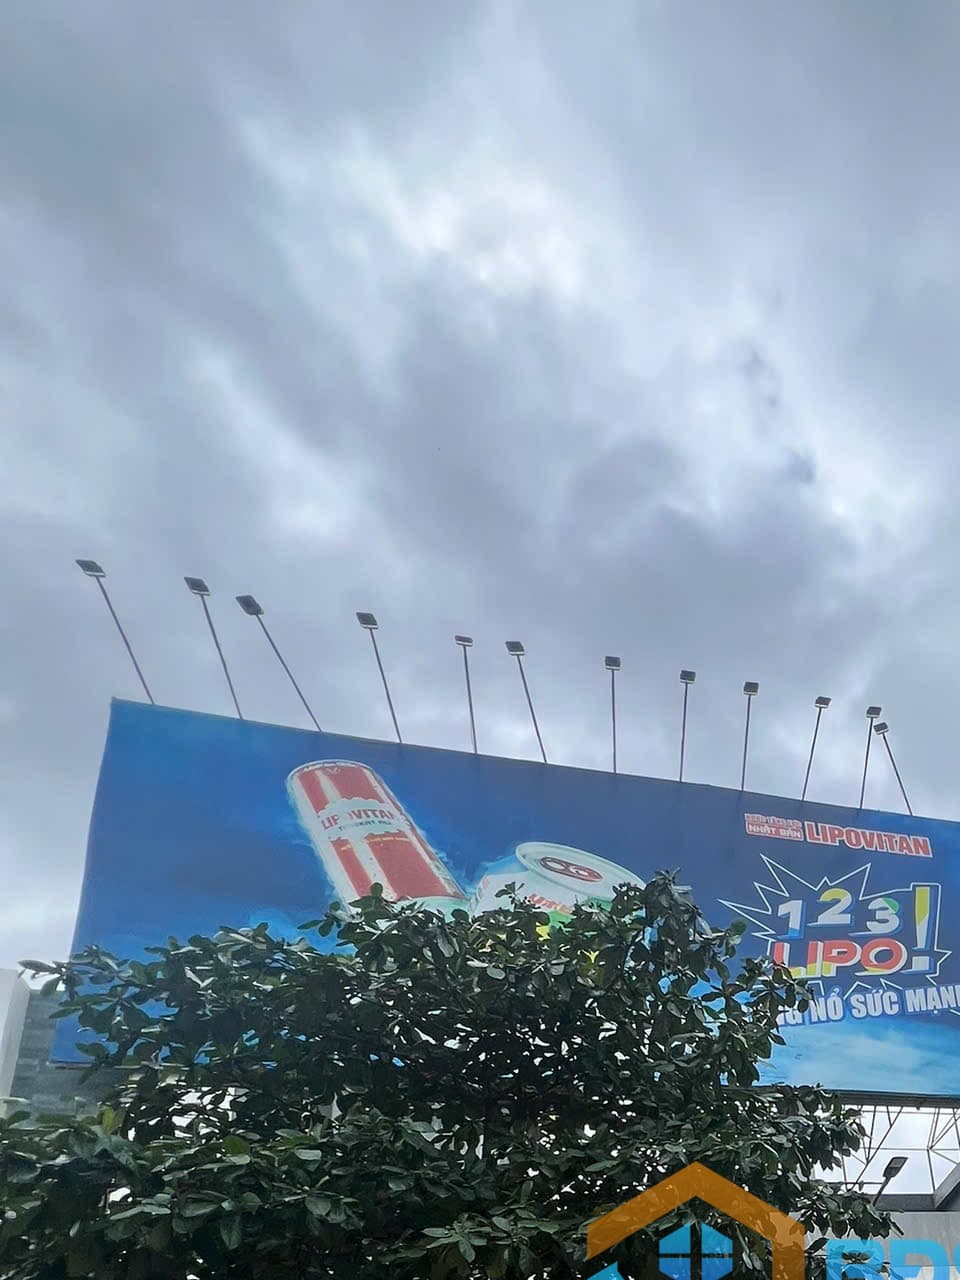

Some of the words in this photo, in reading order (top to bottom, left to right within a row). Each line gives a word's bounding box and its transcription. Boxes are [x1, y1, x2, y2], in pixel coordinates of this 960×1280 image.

[321, 807, 394, 830] LIPVITA
[806, 822, 932, 857] LIPOVITAN
[851, 990, 900, 1018] SỨC
